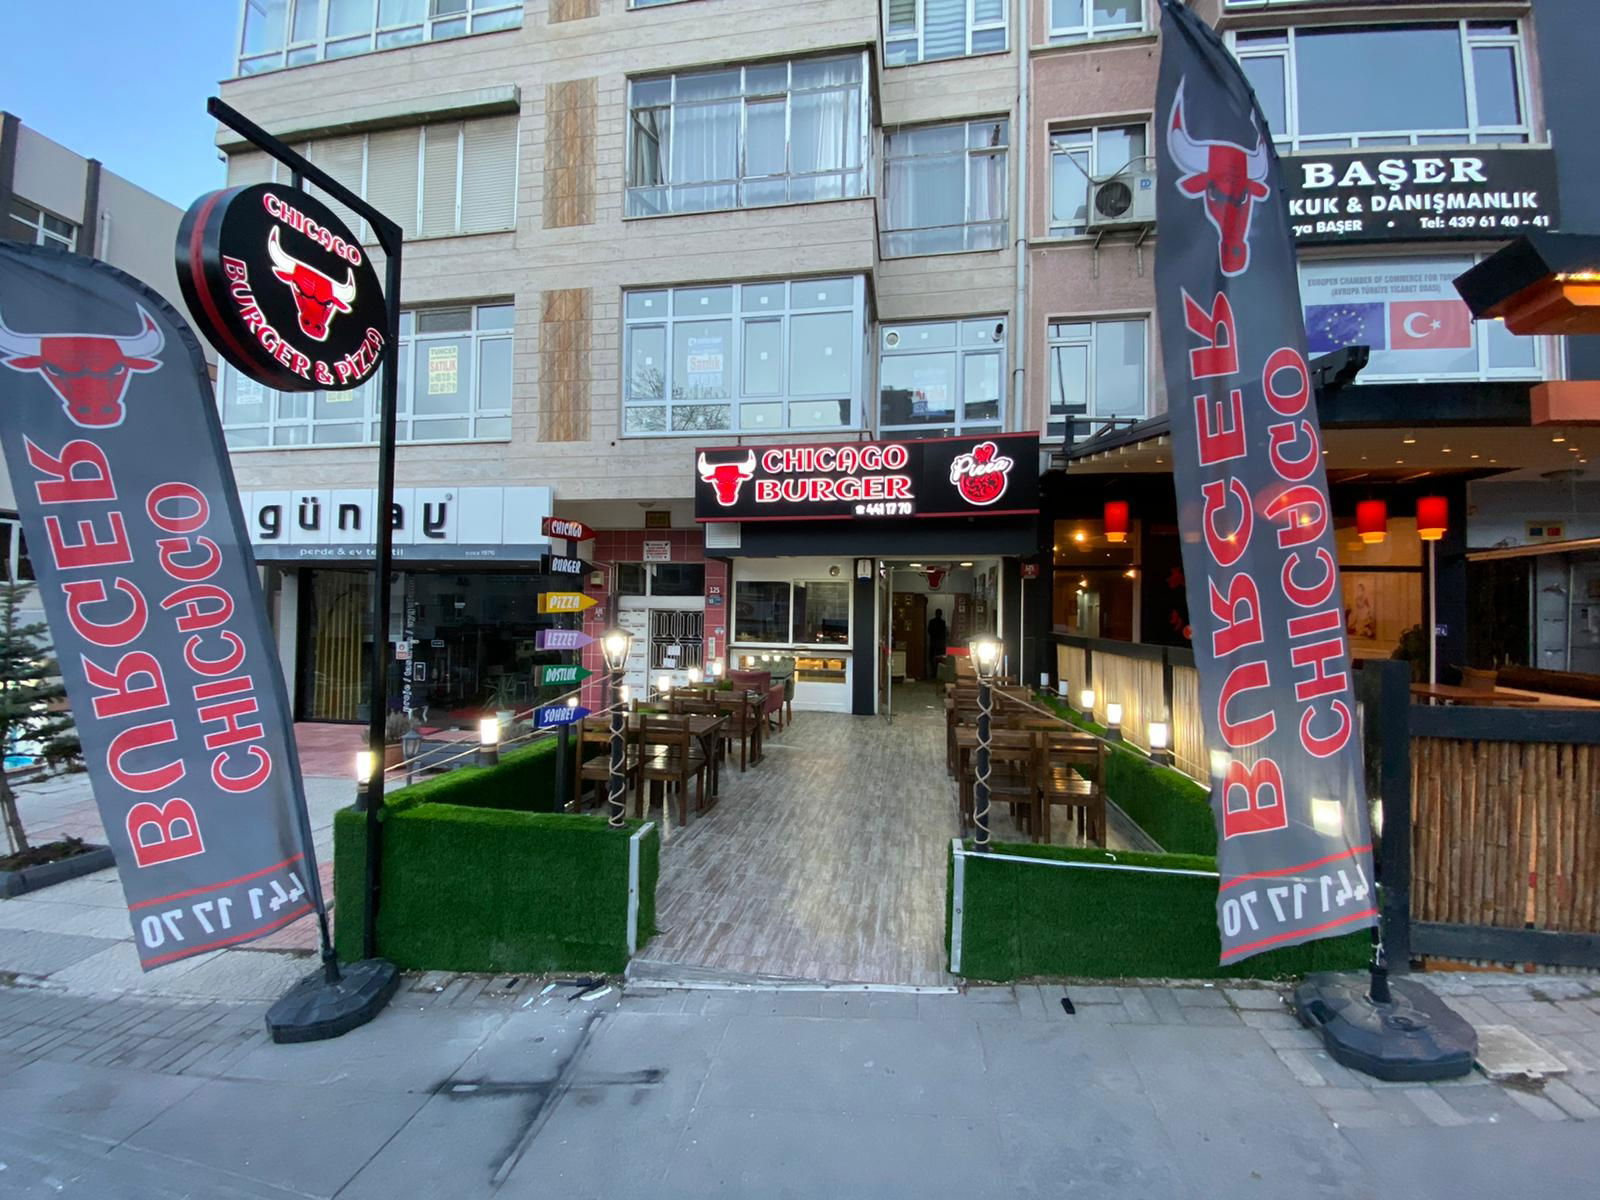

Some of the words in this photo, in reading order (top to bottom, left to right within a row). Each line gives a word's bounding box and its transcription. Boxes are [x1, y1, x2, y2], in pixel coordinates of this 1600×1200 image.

[1301, 157, 1488, 190] BAŞER
[1289, 198, 1339, 216] KUK
[1346, 197, 1363, 213] &
[1371, 192, 1538, 214] DANIŞMANLIK
[263, 193, 362, 266] CHICAGO
[1292, 224, 1312, 236] ya
[1316, 220, 1362, 234] BAŞER
[1420, 216, 1445, 228] Tel:
[1448, 216, 1476, 227] 439
[1479, 216, 1496, 227] 61
[1500, 216, 1519, 227] 40
[1532, 216, 1550, 227] 41
[223, 255, 310, 380] BURGER
[314, 360, 334, 386] &
[761, 445, 908, 474] CHICAGO
[756, 476, 914, 500] BURGER
[866, 503, 884, 515] 441
[886, 502, 897, 515] 17
[898, 502, 912, 514] 70
[552, 520, 582, 538] CHICAGO
[300, 548, 334, 556] perde
[337, 548, 346, 556] &
[366, 548, 404, 556] tetil
[552, 558, 581, 574] BURGER
[547, 632, 578, 646] LEZZET
[546, 667, 577, 682] DOSTLUK
[544, 707, 575, 722] SOHBET
